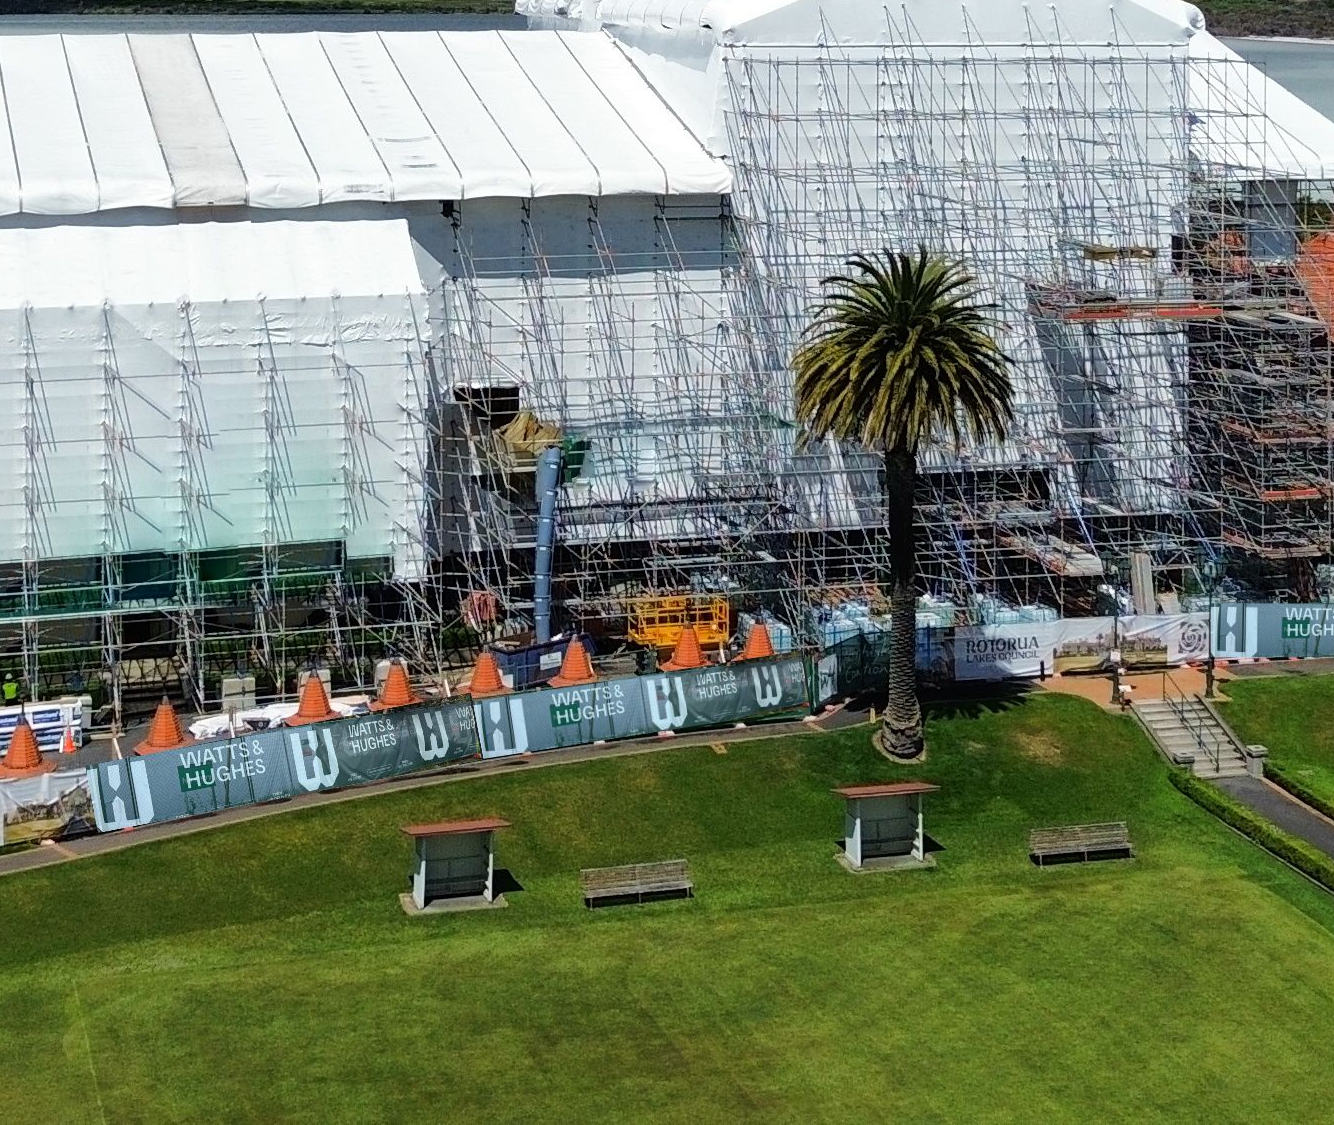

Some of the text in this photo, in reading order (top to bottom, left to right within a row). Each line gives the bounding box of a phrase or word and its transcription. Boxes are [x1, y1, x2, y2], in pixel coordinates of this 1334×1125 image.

[967, 636, 1039, 653] ROTORUA
[967, 650, 1039, 663] LAKES COUNCIL
[697, 672, 728, 686] WATTS
[551, 685, 612, 707] WATTS
[699, 682, 738, 700] HUGHES
[556, 700, 626, 724] HUGHES
[348, 720, 386, 738] WATTS
[351, 733, 397, 754] HUGHES
[179, 741, 250, 769] WATTS
[186, 759, 266, 789] HUGHES
